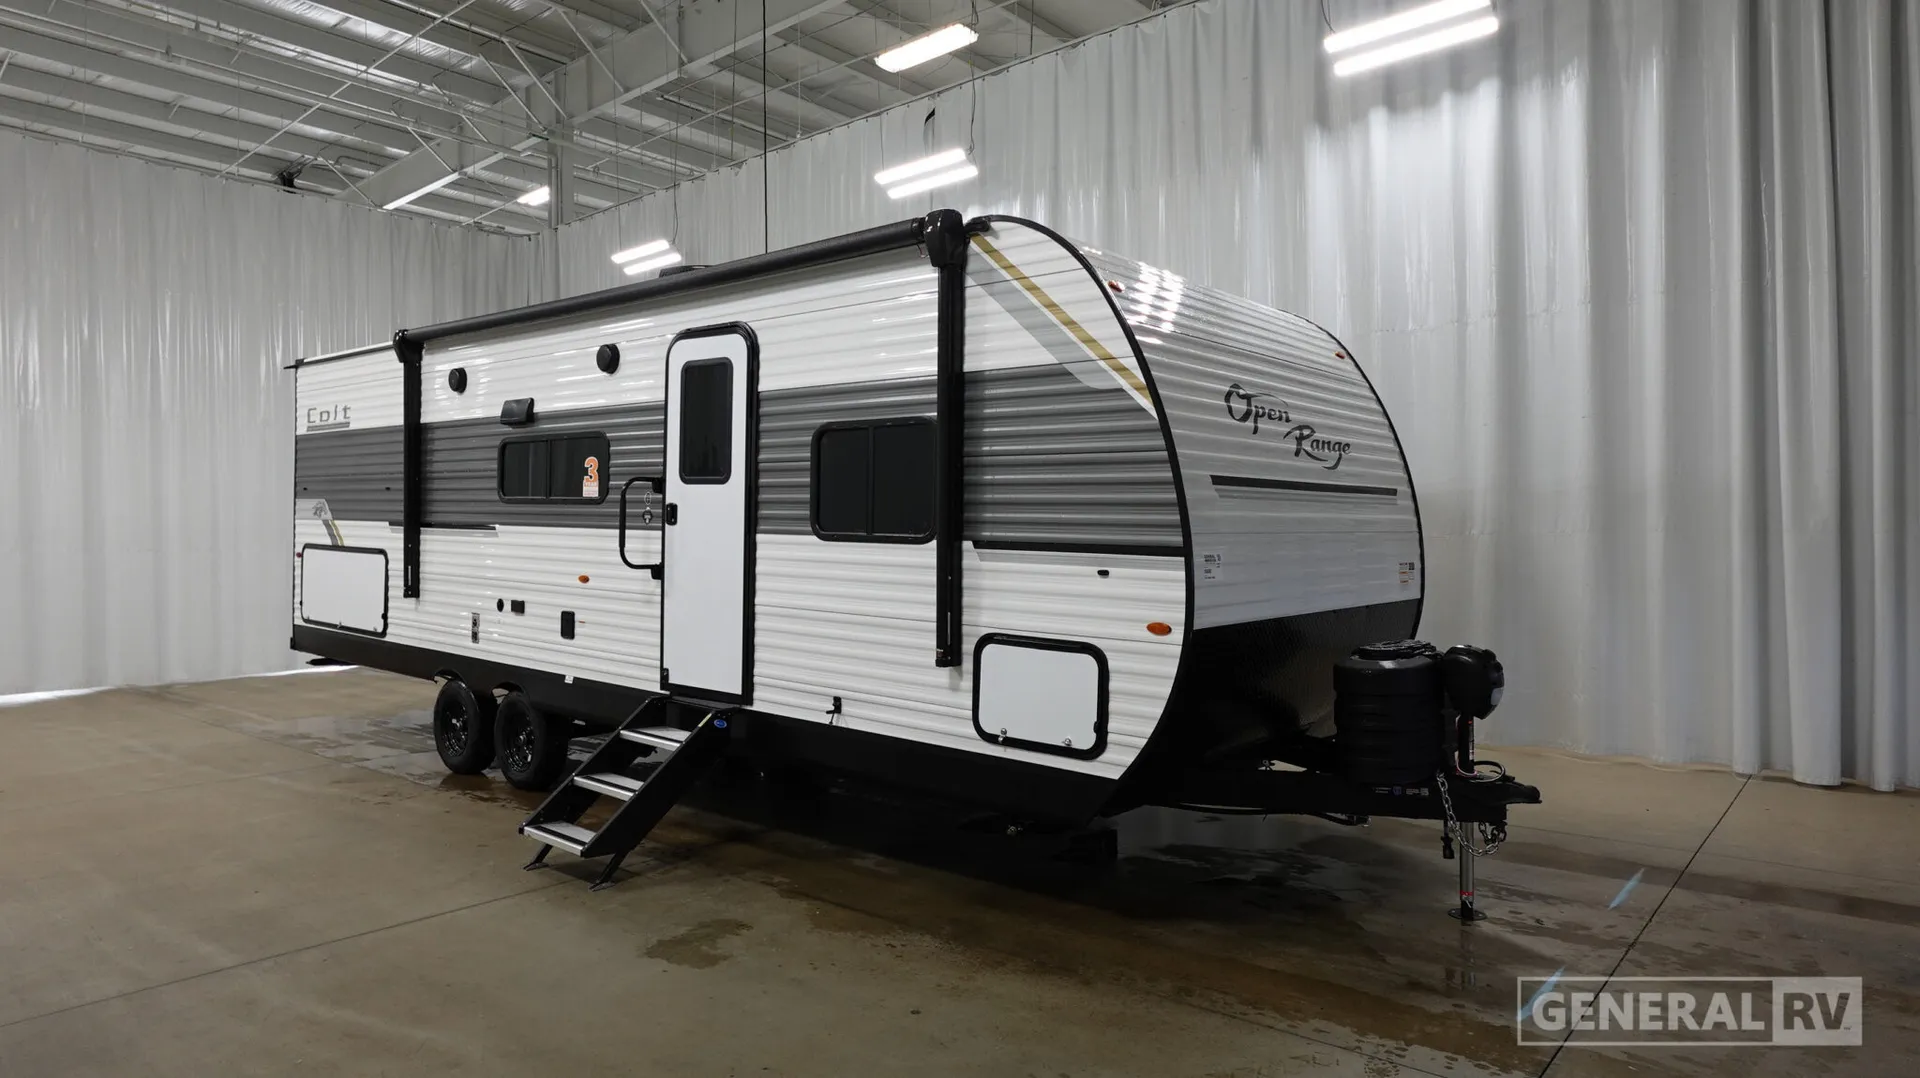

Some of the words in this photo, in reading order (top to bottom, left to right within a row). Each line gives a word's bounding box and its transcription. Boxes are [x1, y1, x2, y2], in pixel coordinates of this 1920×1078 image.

[307, 404, 351, 423] Colt
[1224, 383, 1292, 435] Open
[1283, 424, 1351, 470] Range
[584, 456, 598, 482] 3
